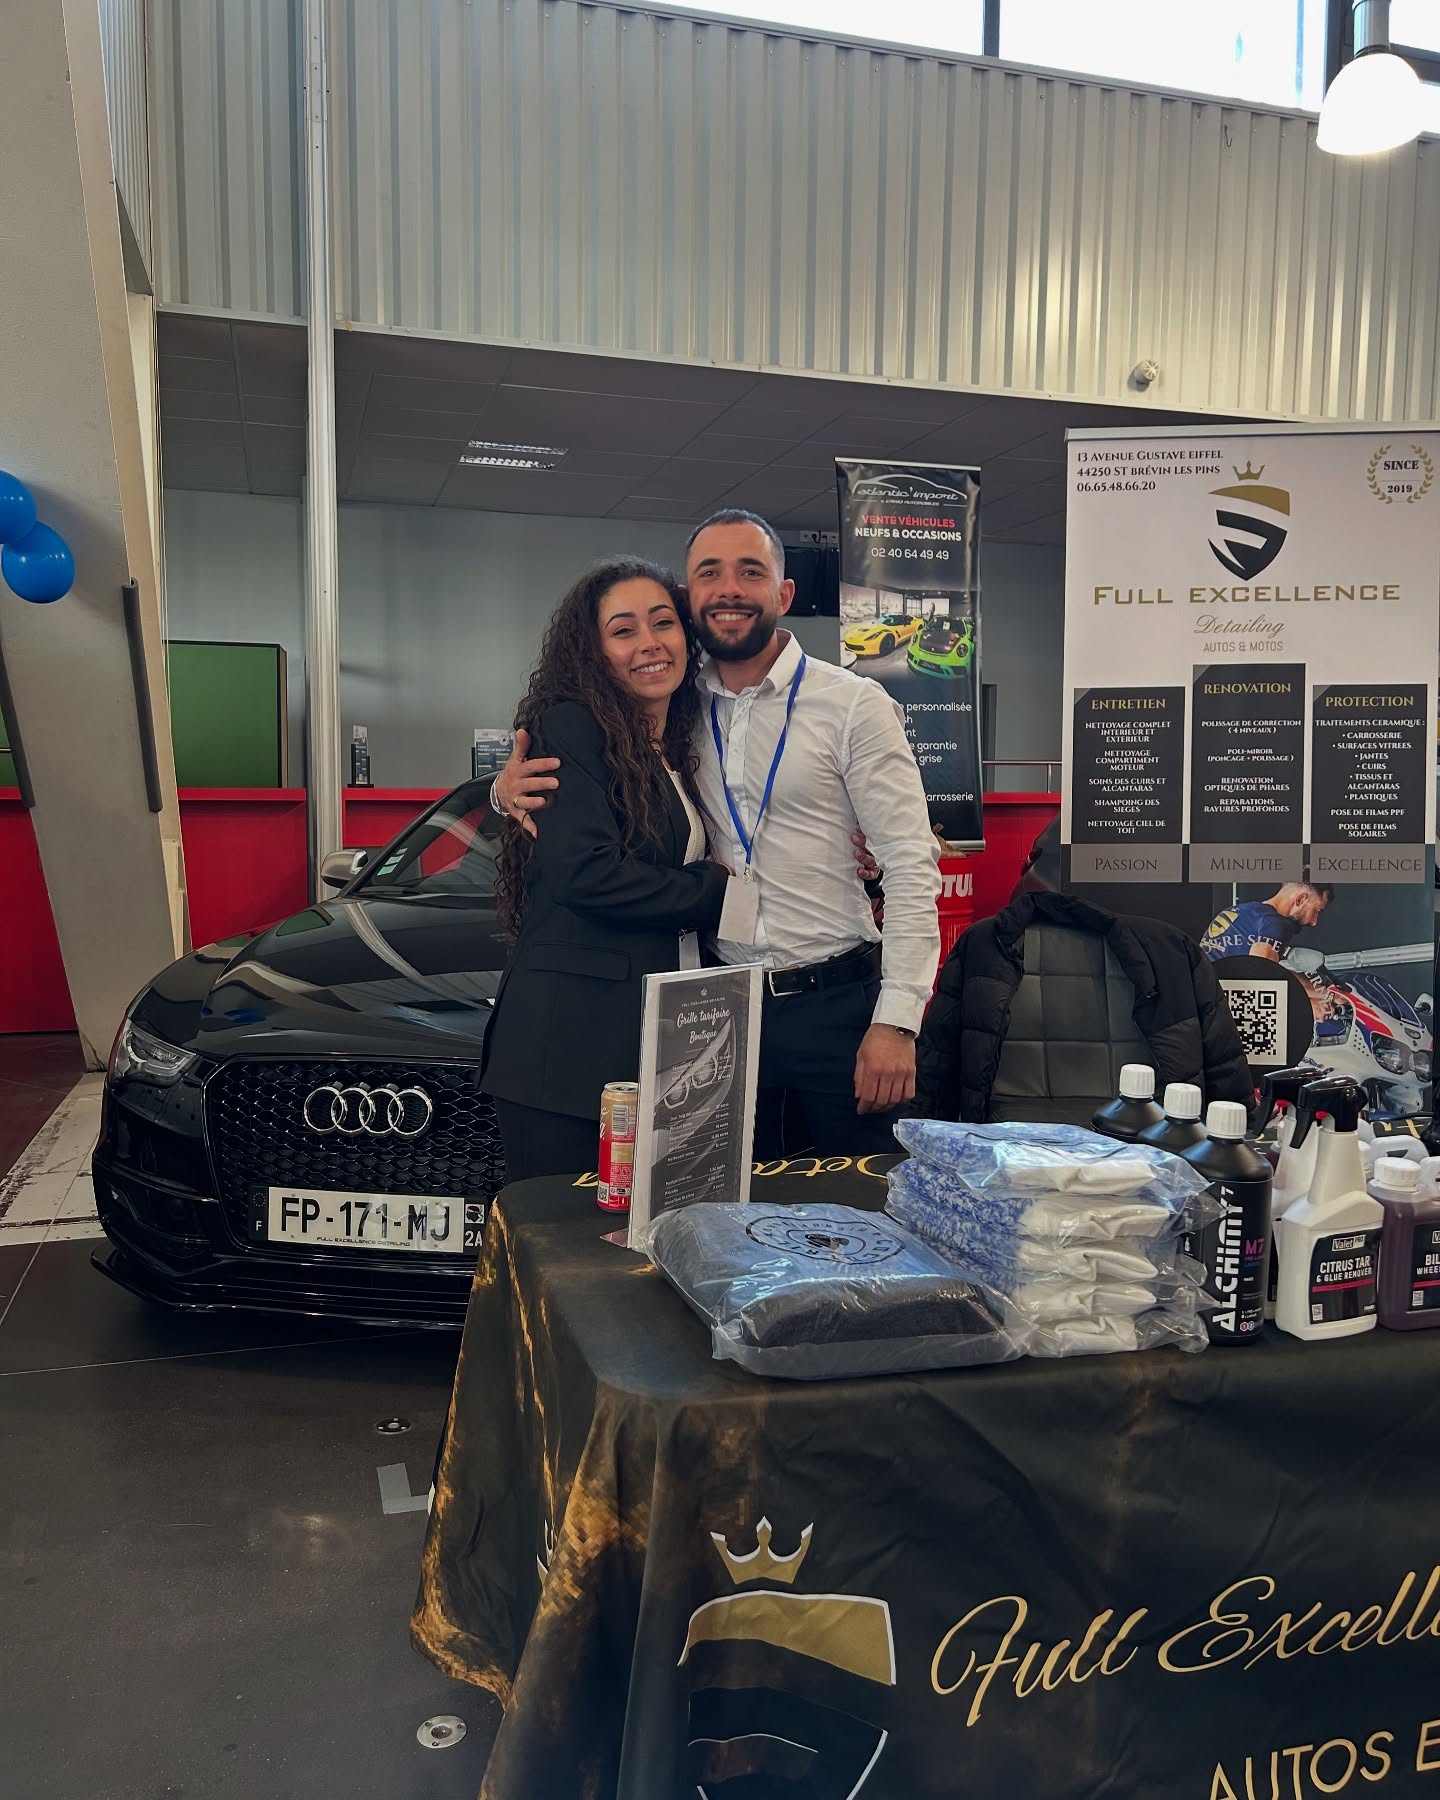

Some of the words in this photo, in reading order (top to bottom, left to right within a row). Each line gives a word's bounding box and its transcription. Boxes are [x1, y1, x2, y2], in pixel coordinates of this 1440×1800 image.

[1077, 452, 1088, 462] 13
[1091, 452, 1134, 461] AVENUE
[1137, 450, 1185, 460] GUSTAVE
[1188, 450, 1223, 459] EIFFEL
[1383, 460, 1419, 470] SINCE
[1077, 467, 1111, 477] 44250
[1114, 466, 1128, 476] ST
[1131, 465, 1170, 476] BRÉVIN
[1174, 466, 1192, 475] LES
[1195, 465, 1220, 474] PINS
[1077, 481, 1156, 492] 06.65.48.66.20
[1387, 484, 1413, 493] 2019
[862, 514, 896, 525] VENTE
[898, 514, 956, 528] VÉHICULES
[855, 527, 891, 538] NEUFS
[892, 529, 900, 538] &
[901, 529, 962, 541] OCCASIONS
[871, 548, 886, 557] 02
[888, 548, 902, 558] 40
[904, 549, 918, 559] 64
[920, 549, 934, 560] 49
[935, 550, 950, 560] 49
[1094, 586, 1174, 605] FULL
[1189, 584, 1400, 604] EXCELLENCE
[1193, 614, 1285, 639] Detailing
[1203, 641, 1236, 652] AUTOS
[1239, 641, 1246, 652] &
[1249, 641, 1284, 652] MOTOS
[1204, 683, 1291, 694] RENOVATION
[1091, 698, 1166, 710] ENTRETIEN
[1325, 696, 1414, 707] PROTECTION
[906, 702, 972, 713] personnalisée
[1085, 721, 1132, 729] NETTOYAGE
[1253, 719, 1302, 727] CORRECTION
[1315, 719, 1371, 727] TRAITEMENTS
[1100, 728, 1143, 736] INTERIEUR
[1106, 735, 1150, 743] EXTERIEUR
[917, 741, 958, 753] garantie
[1337, 742, 1377, 750] SURFACES
[1104, 749, 1151, 757] NETTOYAGE
[919, 754, 942, 766] grise
[1095, 756, 1160, 764] COMPARTIMENT
[1204, 784, 1245, 792] OPTIQUES
[926, 791, 974, 801] arrosserie
[1349, 793, 1399, 802] PLASTIQUES
[1220, 798, 1275, 806] REPARATIONS
[1330, 808, 1351, 816] POSE
[1365, 808, 1389, 816] FILMS
[1390, 808, 1405, 816] PPF
[1348, 830, 1387, 838] SOLAIRES
[1095, 858, 1158, 870] PASSION
[1210, 857, 1283, 871] MINUTIE
[1318, 857, 1422, 871] EXCELLENCE
[942, 873, 973, 898] TUL
[677, 1010, 698, 1028] Grille
[699, 1007, 731, 1026] tarifaire
[281, 1197, 450, 1241] FP-171-MJ
[255, 1221, 262, 1231] F
[464, 1230, 483, 1246] 2A
[1245, 1238, 1265, 1254] M7
[1335, 1239, 1353, 1249] Valet
[1320, 1259, 1354, 1273] CITRUS
[1355, 1255, 1371, 1269] TAR
[1316, 1275, 1322, 1283] &
[1324, 1272, 1343, 1282] GLUE
[1344, 1267, 1372, 1280] REMOVER
[931, 1595, 1149, 1727] Full
